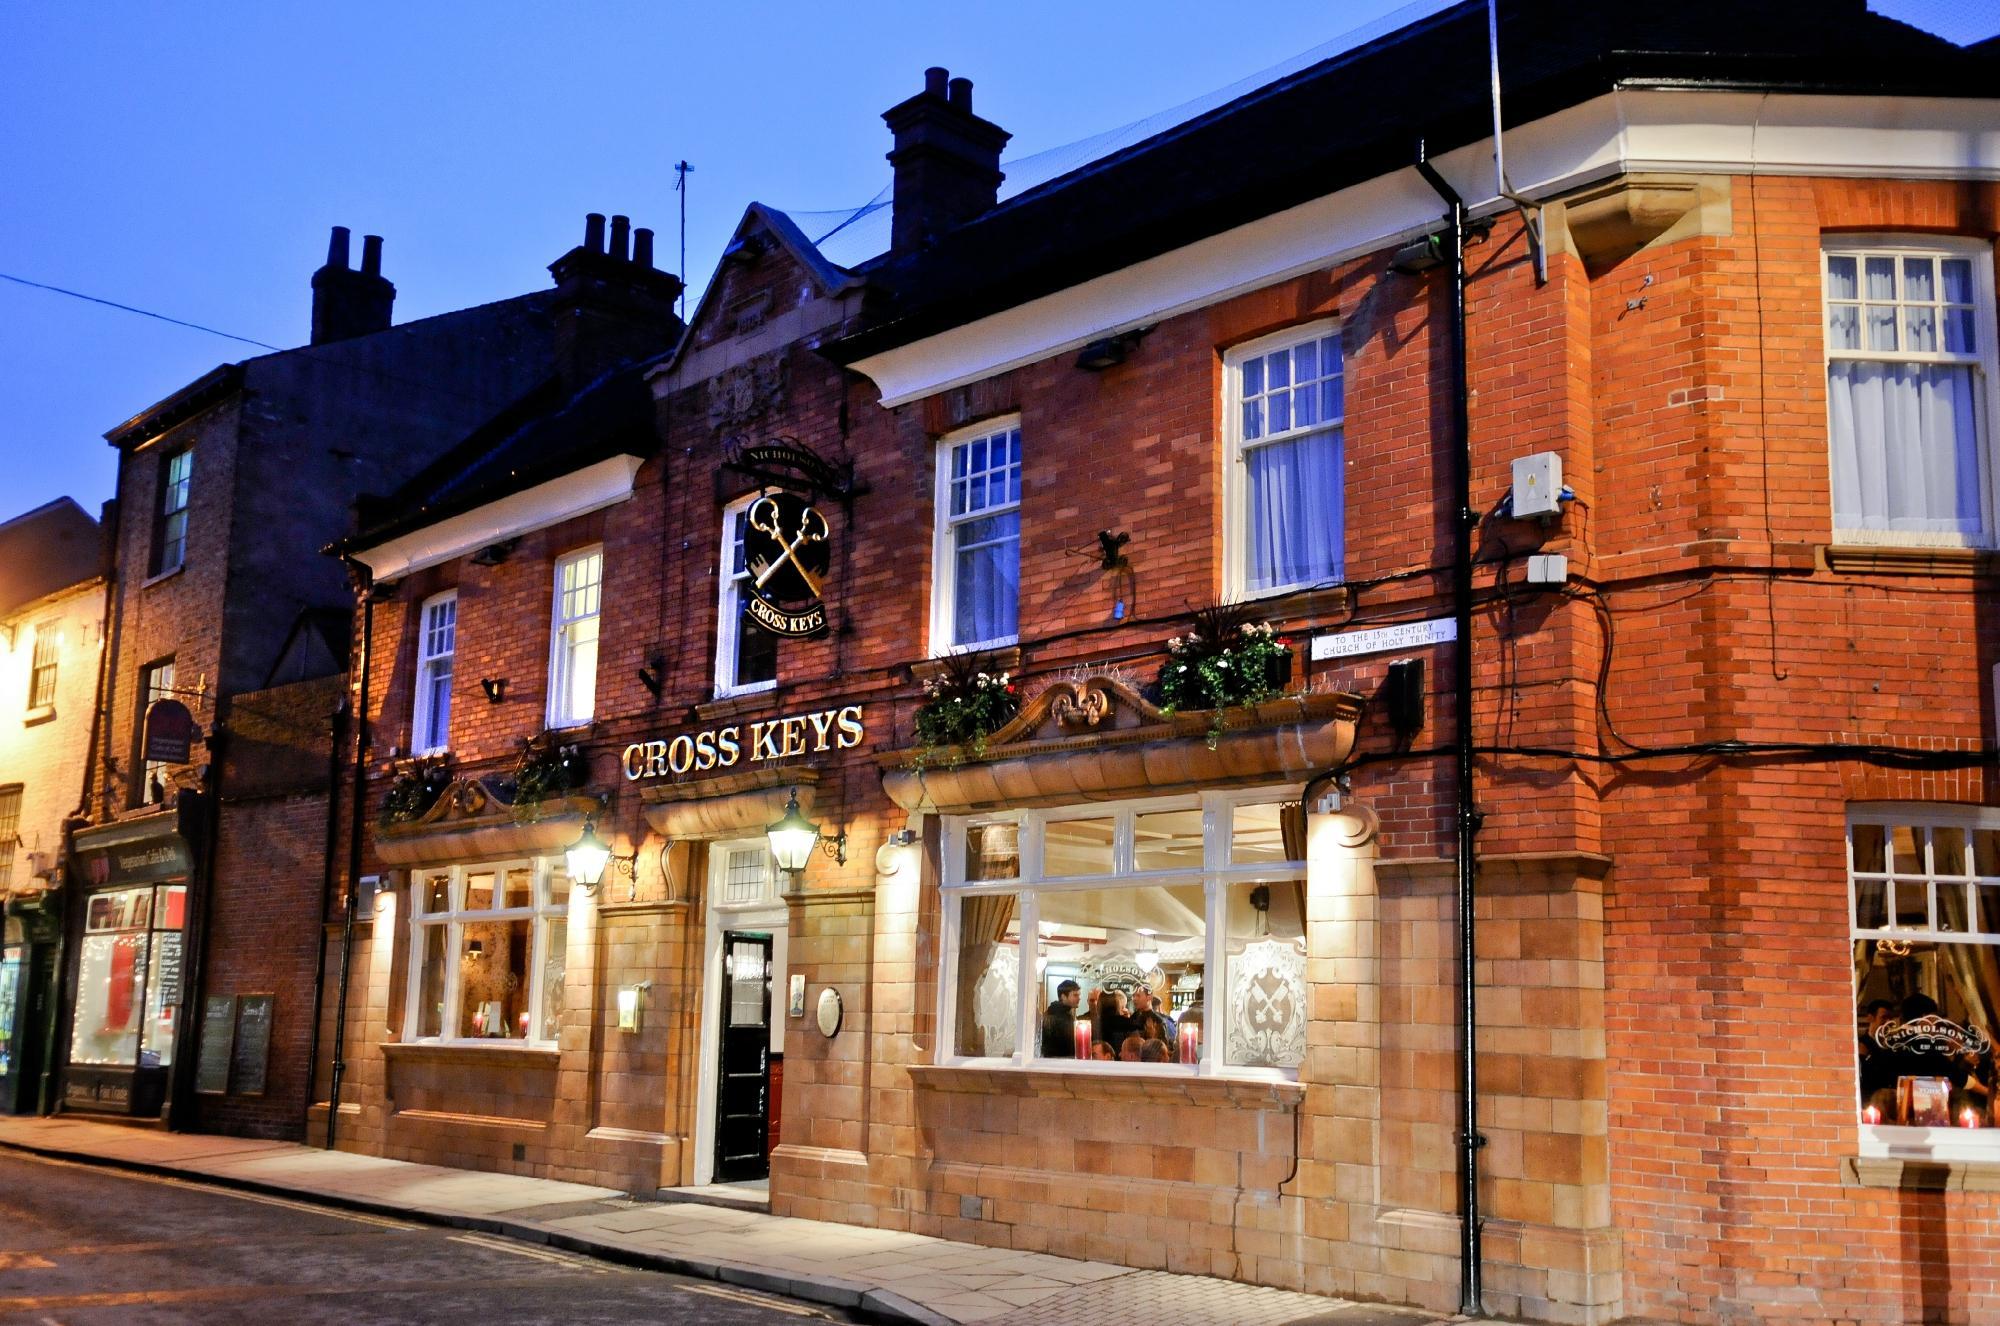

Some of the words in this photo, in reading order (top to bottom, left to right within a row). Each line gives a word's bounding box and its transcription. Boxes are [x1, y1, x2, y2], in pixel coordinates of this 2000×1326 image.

[751, 598, 788, 630] CROSS
[789, 611, 823, 631] KEYS
[1323, 645, 1360, 656] CHURCH
[1366, 642, 1377, 650] OF
[1382, 638, 1404, 648] HOLY
[1410, 631, 1446, 643] TRINITY
[1353, 632, 1369, 641] THE
[1393, 623, 1433, 637] CENTURY
[622, 726, 740, 781] CROSS
[750, 705, 864, 762] KEYS
[1893, 1024, 1974, 1046] NICHOLSON'S
